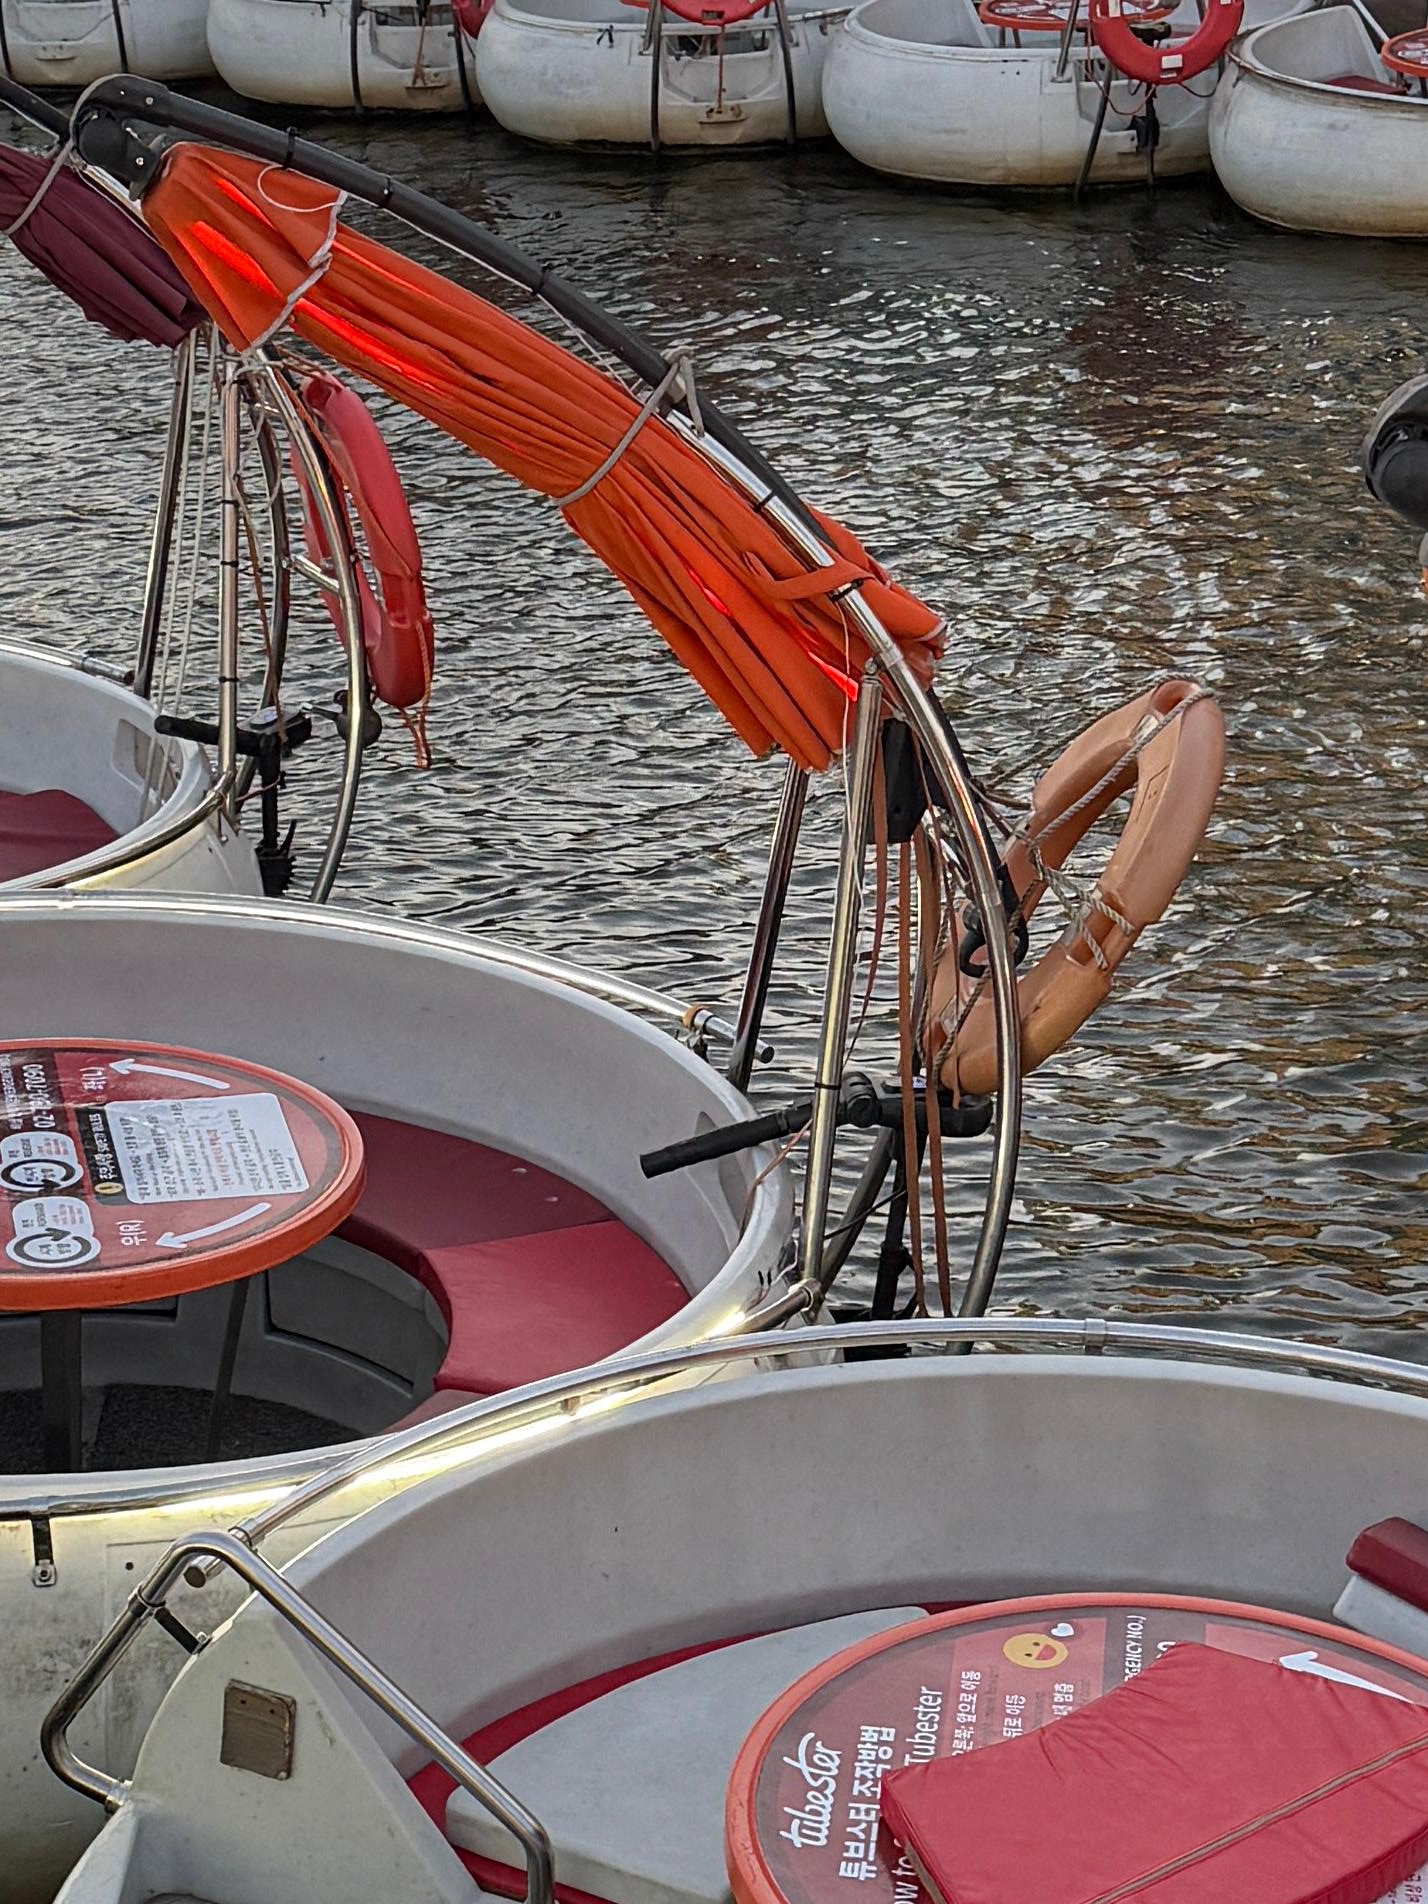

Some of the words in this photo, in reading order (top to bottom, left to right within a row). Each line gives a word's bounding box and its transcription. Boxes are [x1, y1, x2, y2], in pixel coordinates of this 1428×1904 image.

[115, 1219, 148, 1247] 우(R)
[1125, 1615, 1147, 1641] NO.)
[961, 1671, 982, 1691] 이동
[1005, 1694, 1027, 1715] 이동
[904, 1685, 943, 1766] Tubester
[1002, 1714, 1023, 1738] 뒤로
[852, 1724, 897, 1800] 조작방법
[779, 1731, 843, 1848] tubester
[838, 1802, 881, 1881] 튜브스터
[891, 1855, 914, 1877] to
